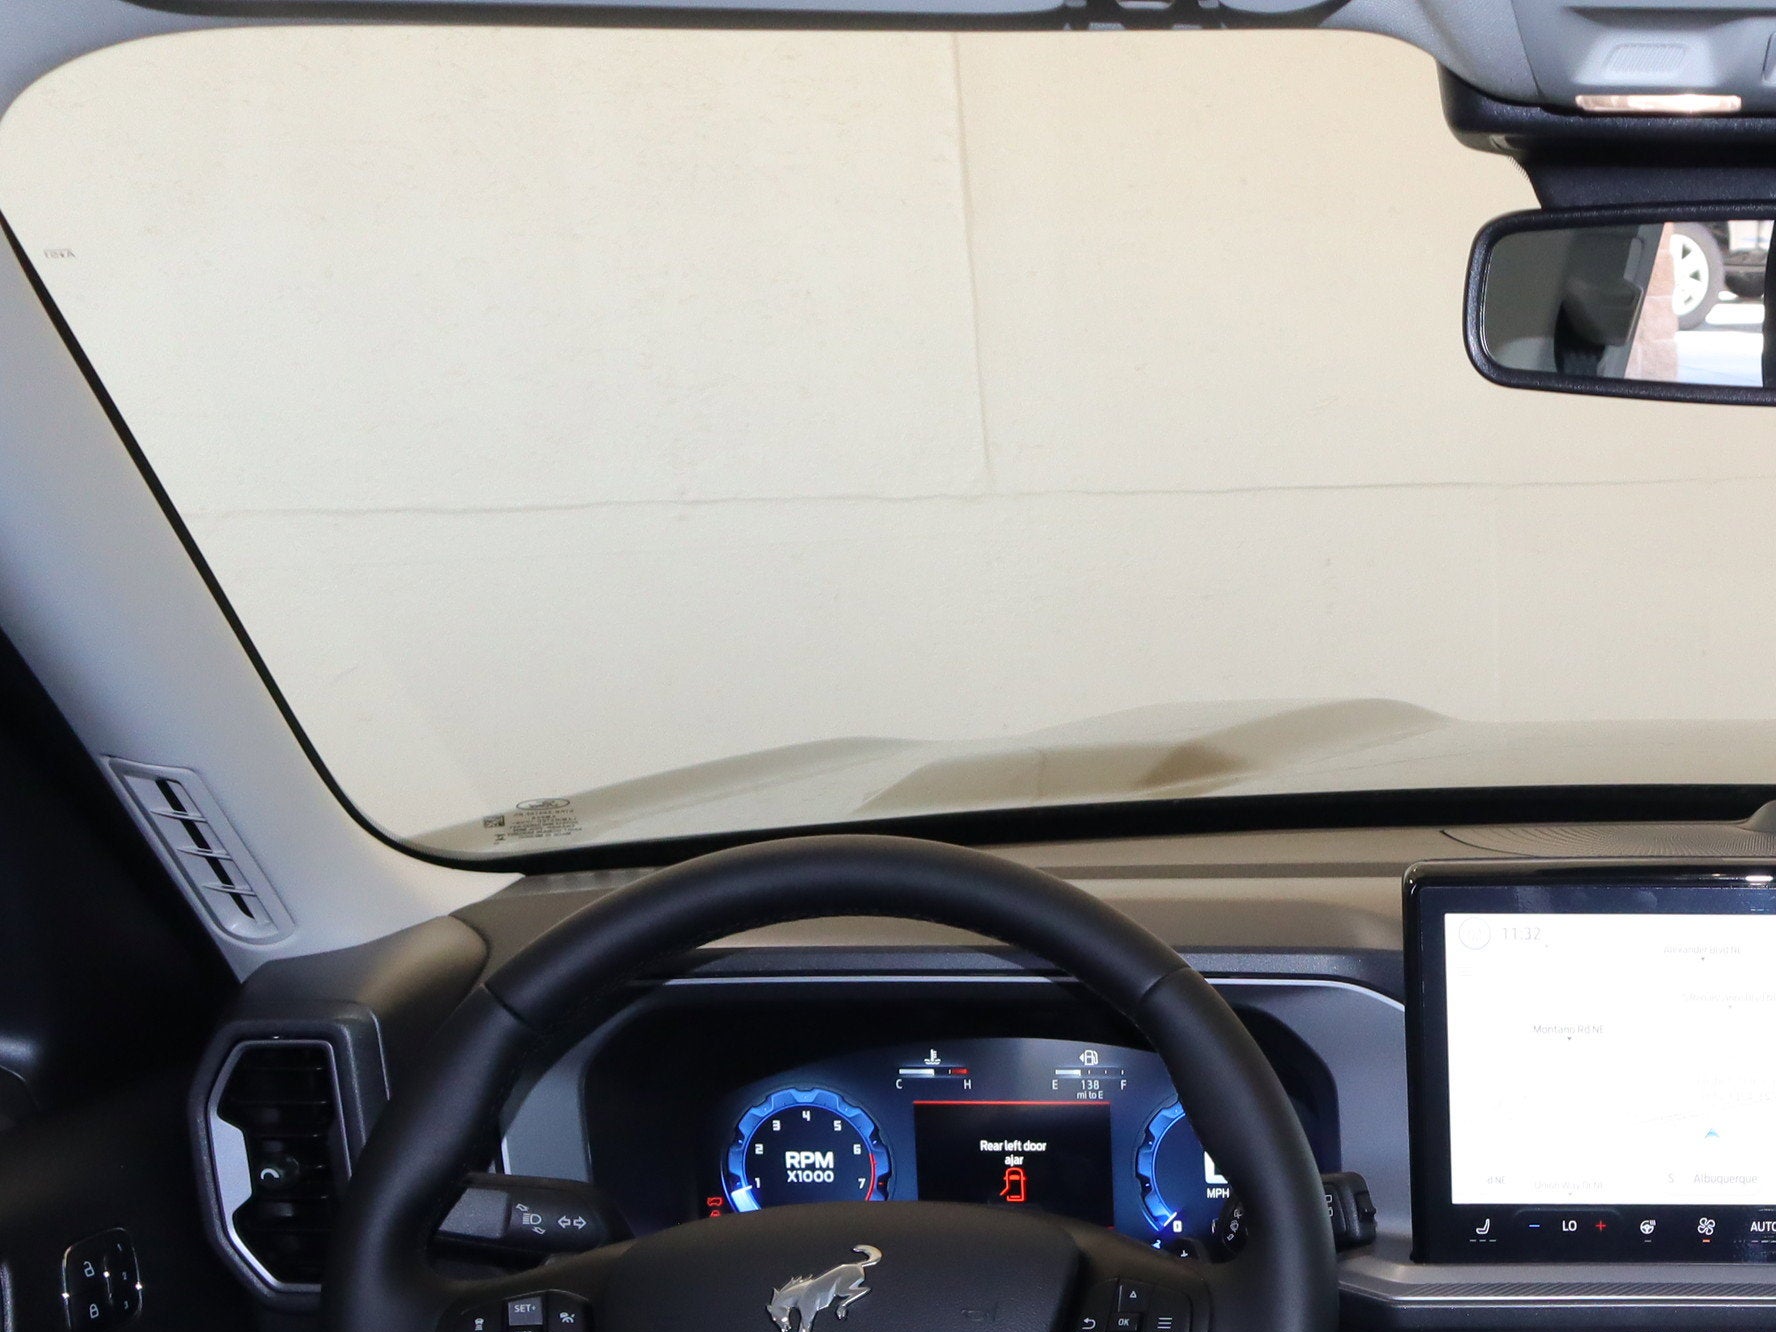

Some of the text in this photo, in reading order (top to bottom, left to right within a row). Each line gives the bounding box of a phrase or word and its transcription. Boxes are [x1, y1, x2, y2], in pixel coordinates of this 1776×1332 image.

[896, 1079, 903, 1090] C
[964, 1080, 972, 1090] H
[1052, 1080, 1058, 1090] E
[1080, 1080, 1100, 1090] 138
[1120, 1080, 1127, 1090] F
[1076, 1091, 1103, 1100] mi to E
[802, 1110, 811, 1121] 4
[772, 1120, 781, 1131] 3
[833, 1120, 842, 1131] 5
[755, 1143, 764, 1155] 2
[853, 1144, 861, 1155] 6
[980, 1140, 1047, 1152] Rear left door
[785, 1151, 834, 1169] RPM
[1004, 1154, 1024, 1167] ajar
[787, 1170, 834, 1183] X1000
[1693, 1173, 1758, 1186] Albuquerque
[755, 1177, 761, 1189] 1
[858, 1178, 866, 1189] 7
[1207, 1188, 1230, 1198] MPH
[1173, 1220, 1182, 1232] 0
[1562, 1220, 1577, 1232] LO
[513, 1303, 537, 1314] SET+
[1118, 1317, 1130, 1327] OK
